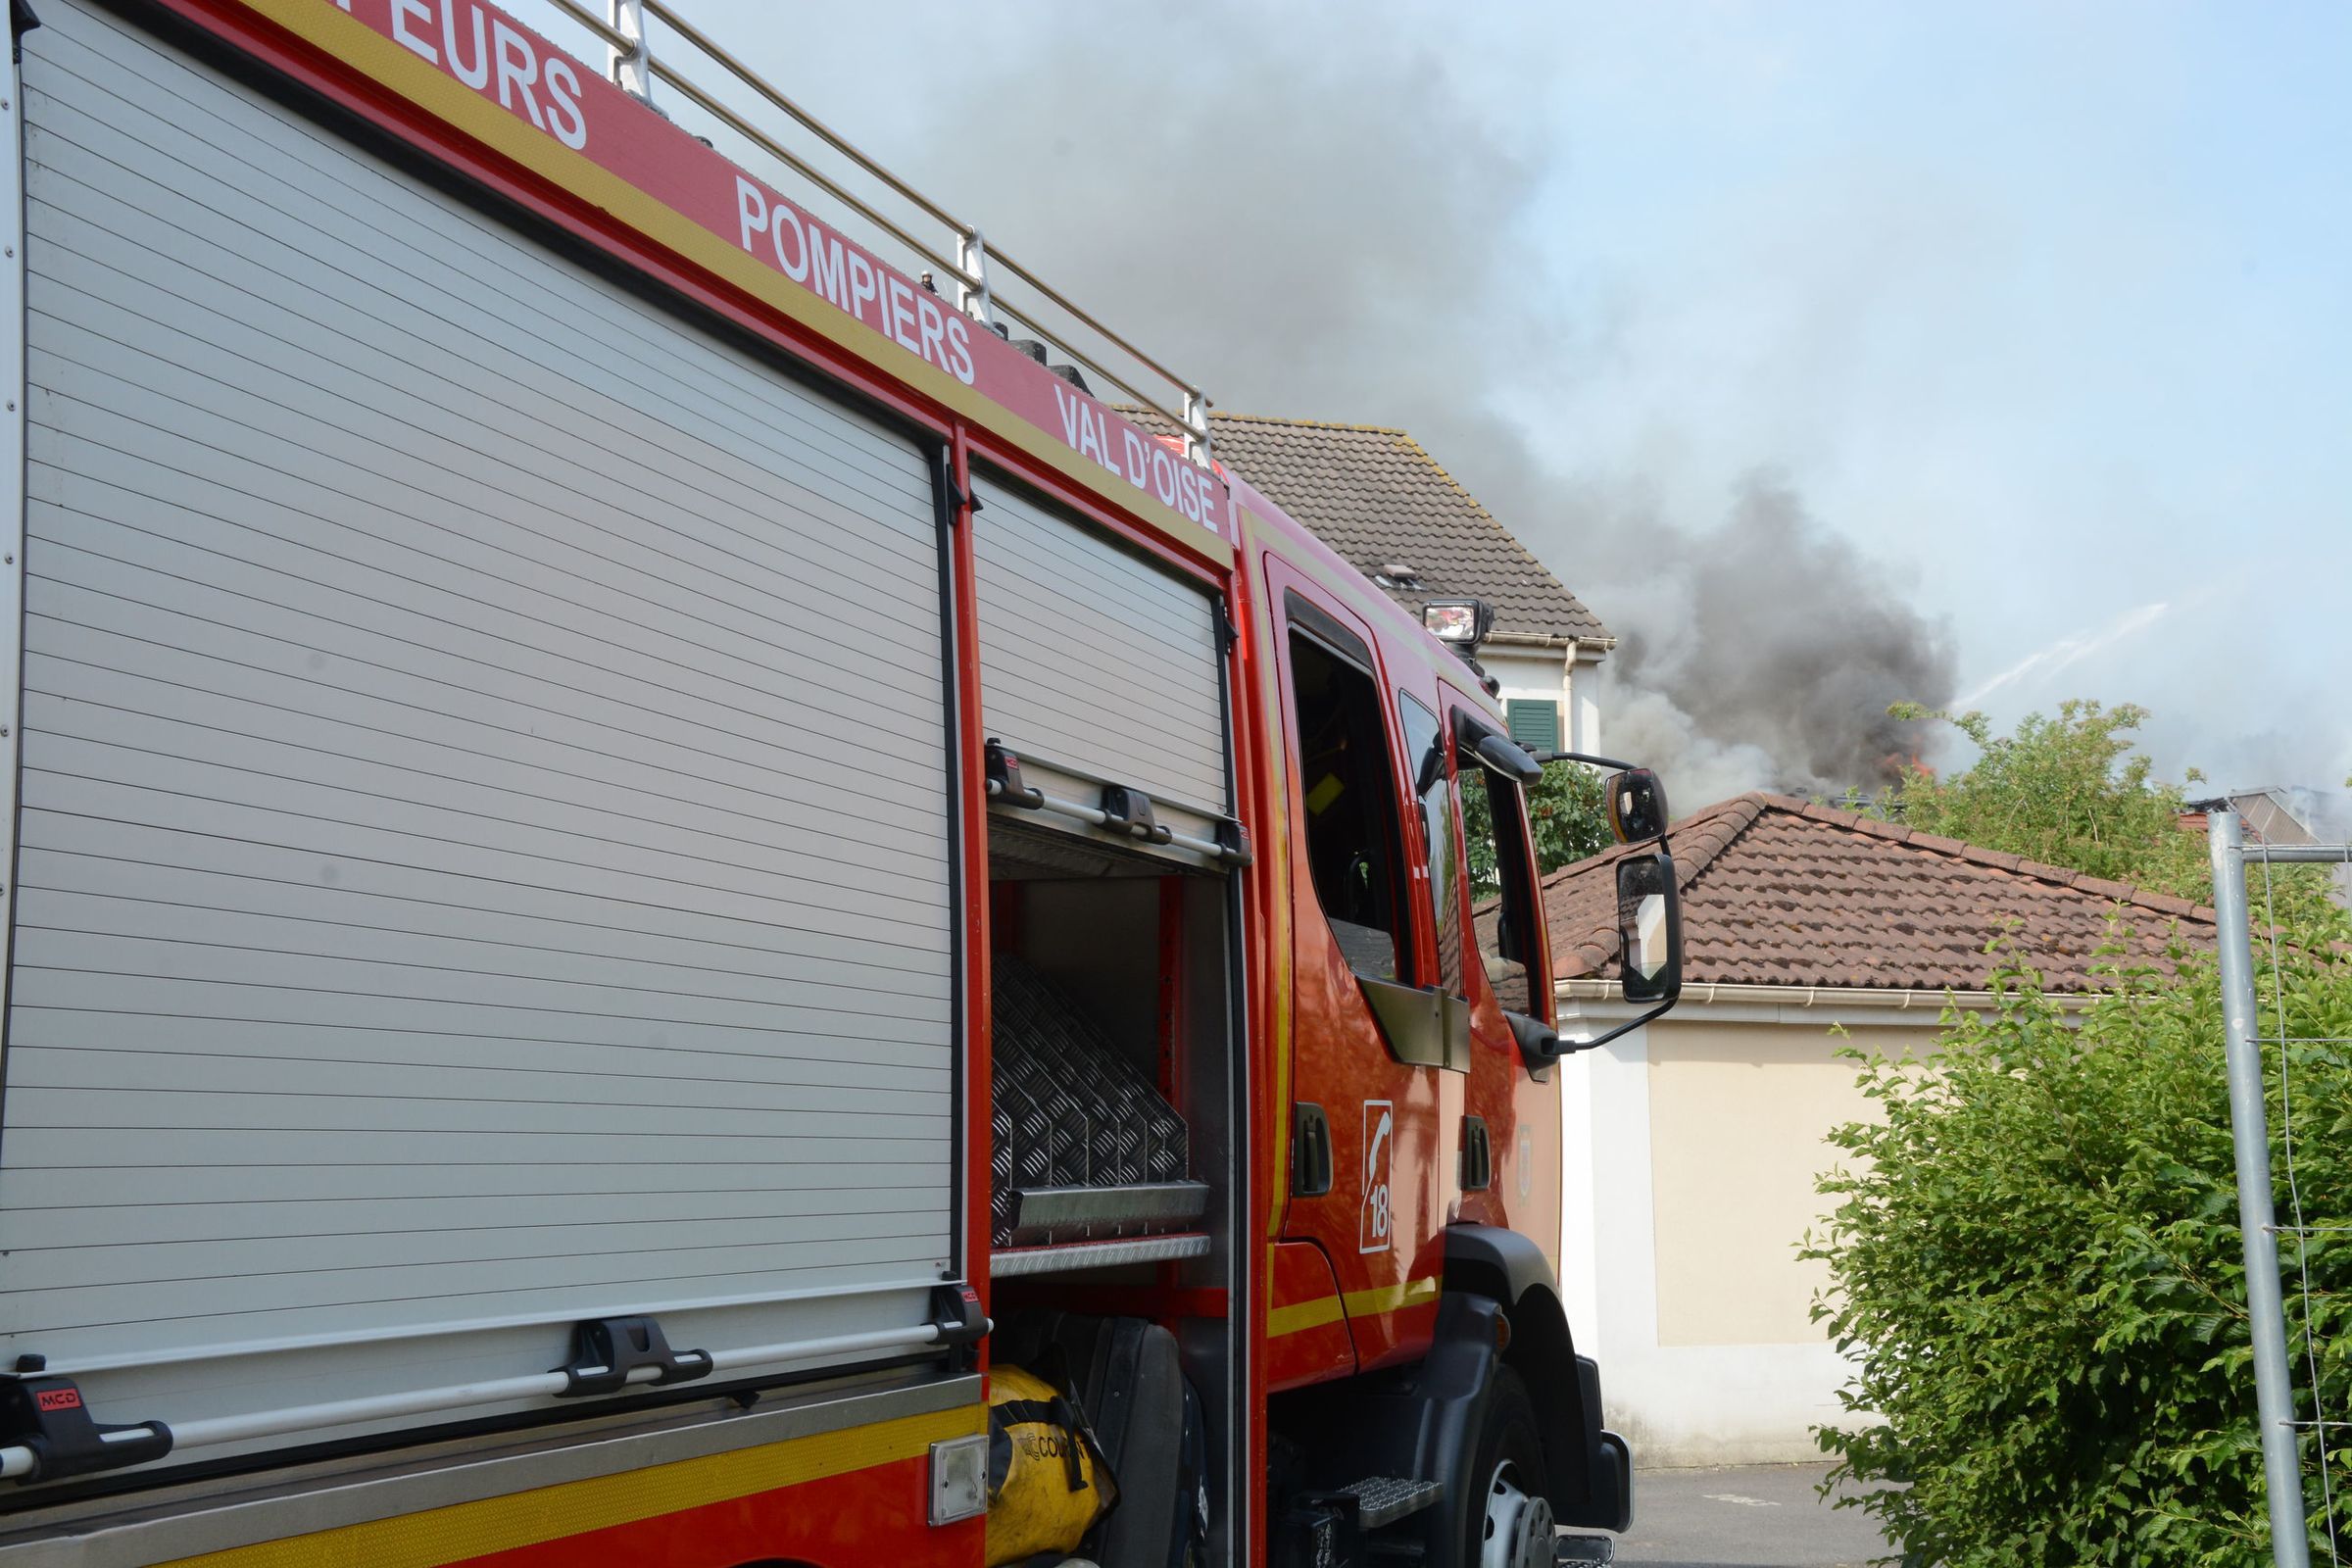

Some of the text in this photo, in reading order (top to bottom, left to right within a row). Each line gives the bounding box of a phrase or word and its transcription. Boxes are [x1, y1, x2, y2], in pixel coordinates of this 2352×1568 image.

[336, 0, 1218, 533] EURS POMPIERS VAL D'OISE
[1371, 1185, 1388, 1238] 18
[41, 1393, 75, 1406] MCD
